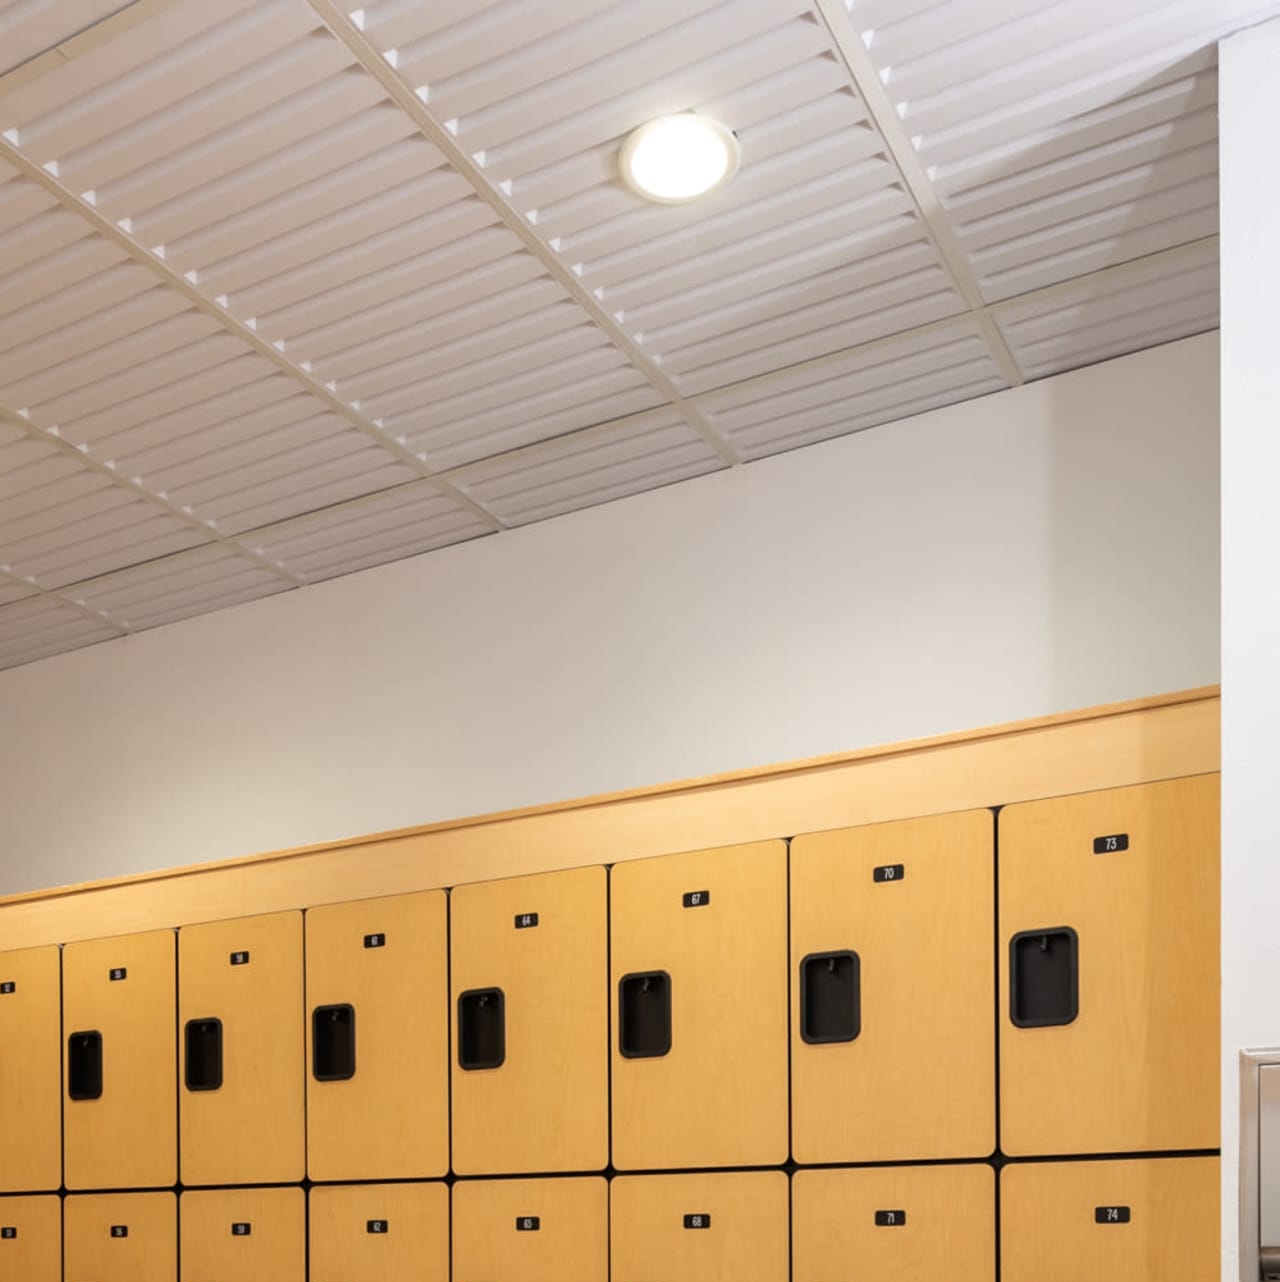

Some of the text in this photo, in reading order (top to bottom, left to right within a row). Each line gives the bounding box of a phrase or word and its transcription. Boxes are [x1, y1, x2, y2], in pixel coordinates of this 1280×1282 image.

[1105, 836, 1118, 851] 73
[883, 867, 895, 880] 70
[691, 893, 701, 905] 67
[886, 1212, 895, 1224] 71
[1106, 1208, 1119, 1221] 74
[692, 1216, 702, 1227] 68
